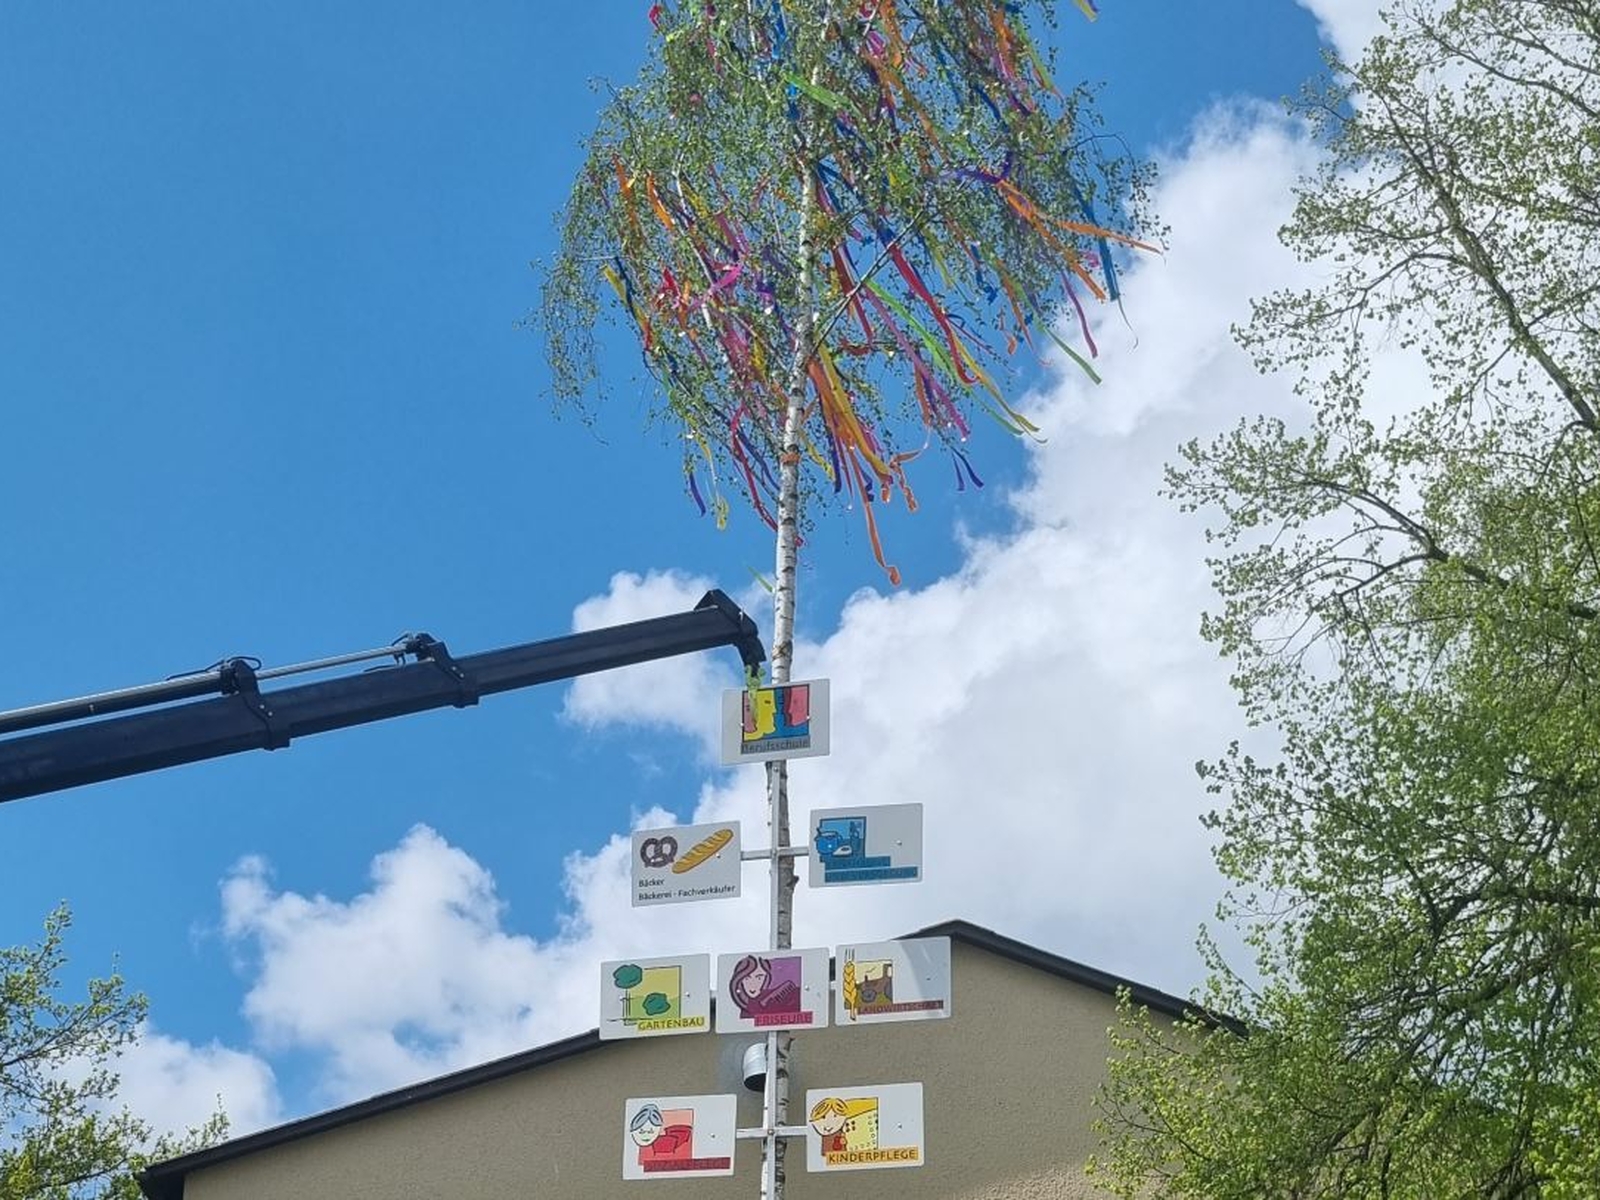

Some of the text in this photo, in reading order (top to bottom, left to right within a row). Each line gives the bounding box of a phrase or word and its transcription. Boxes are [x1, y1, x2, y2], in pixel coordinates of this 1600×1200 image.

[742, 738, 809, 753] Berufsschule
[638, 878, 665, 887] Bäcker
[638, 891, 672, 900] Bäckerei
[678, 885, 736, 897] Fachverkäufer
[638, 1018, 705, 1030] GARTENBAU
[756, 1013, 812, 1025] FRISEURE
[828, 1149, 916, 1163] KINDERPFLEGE
